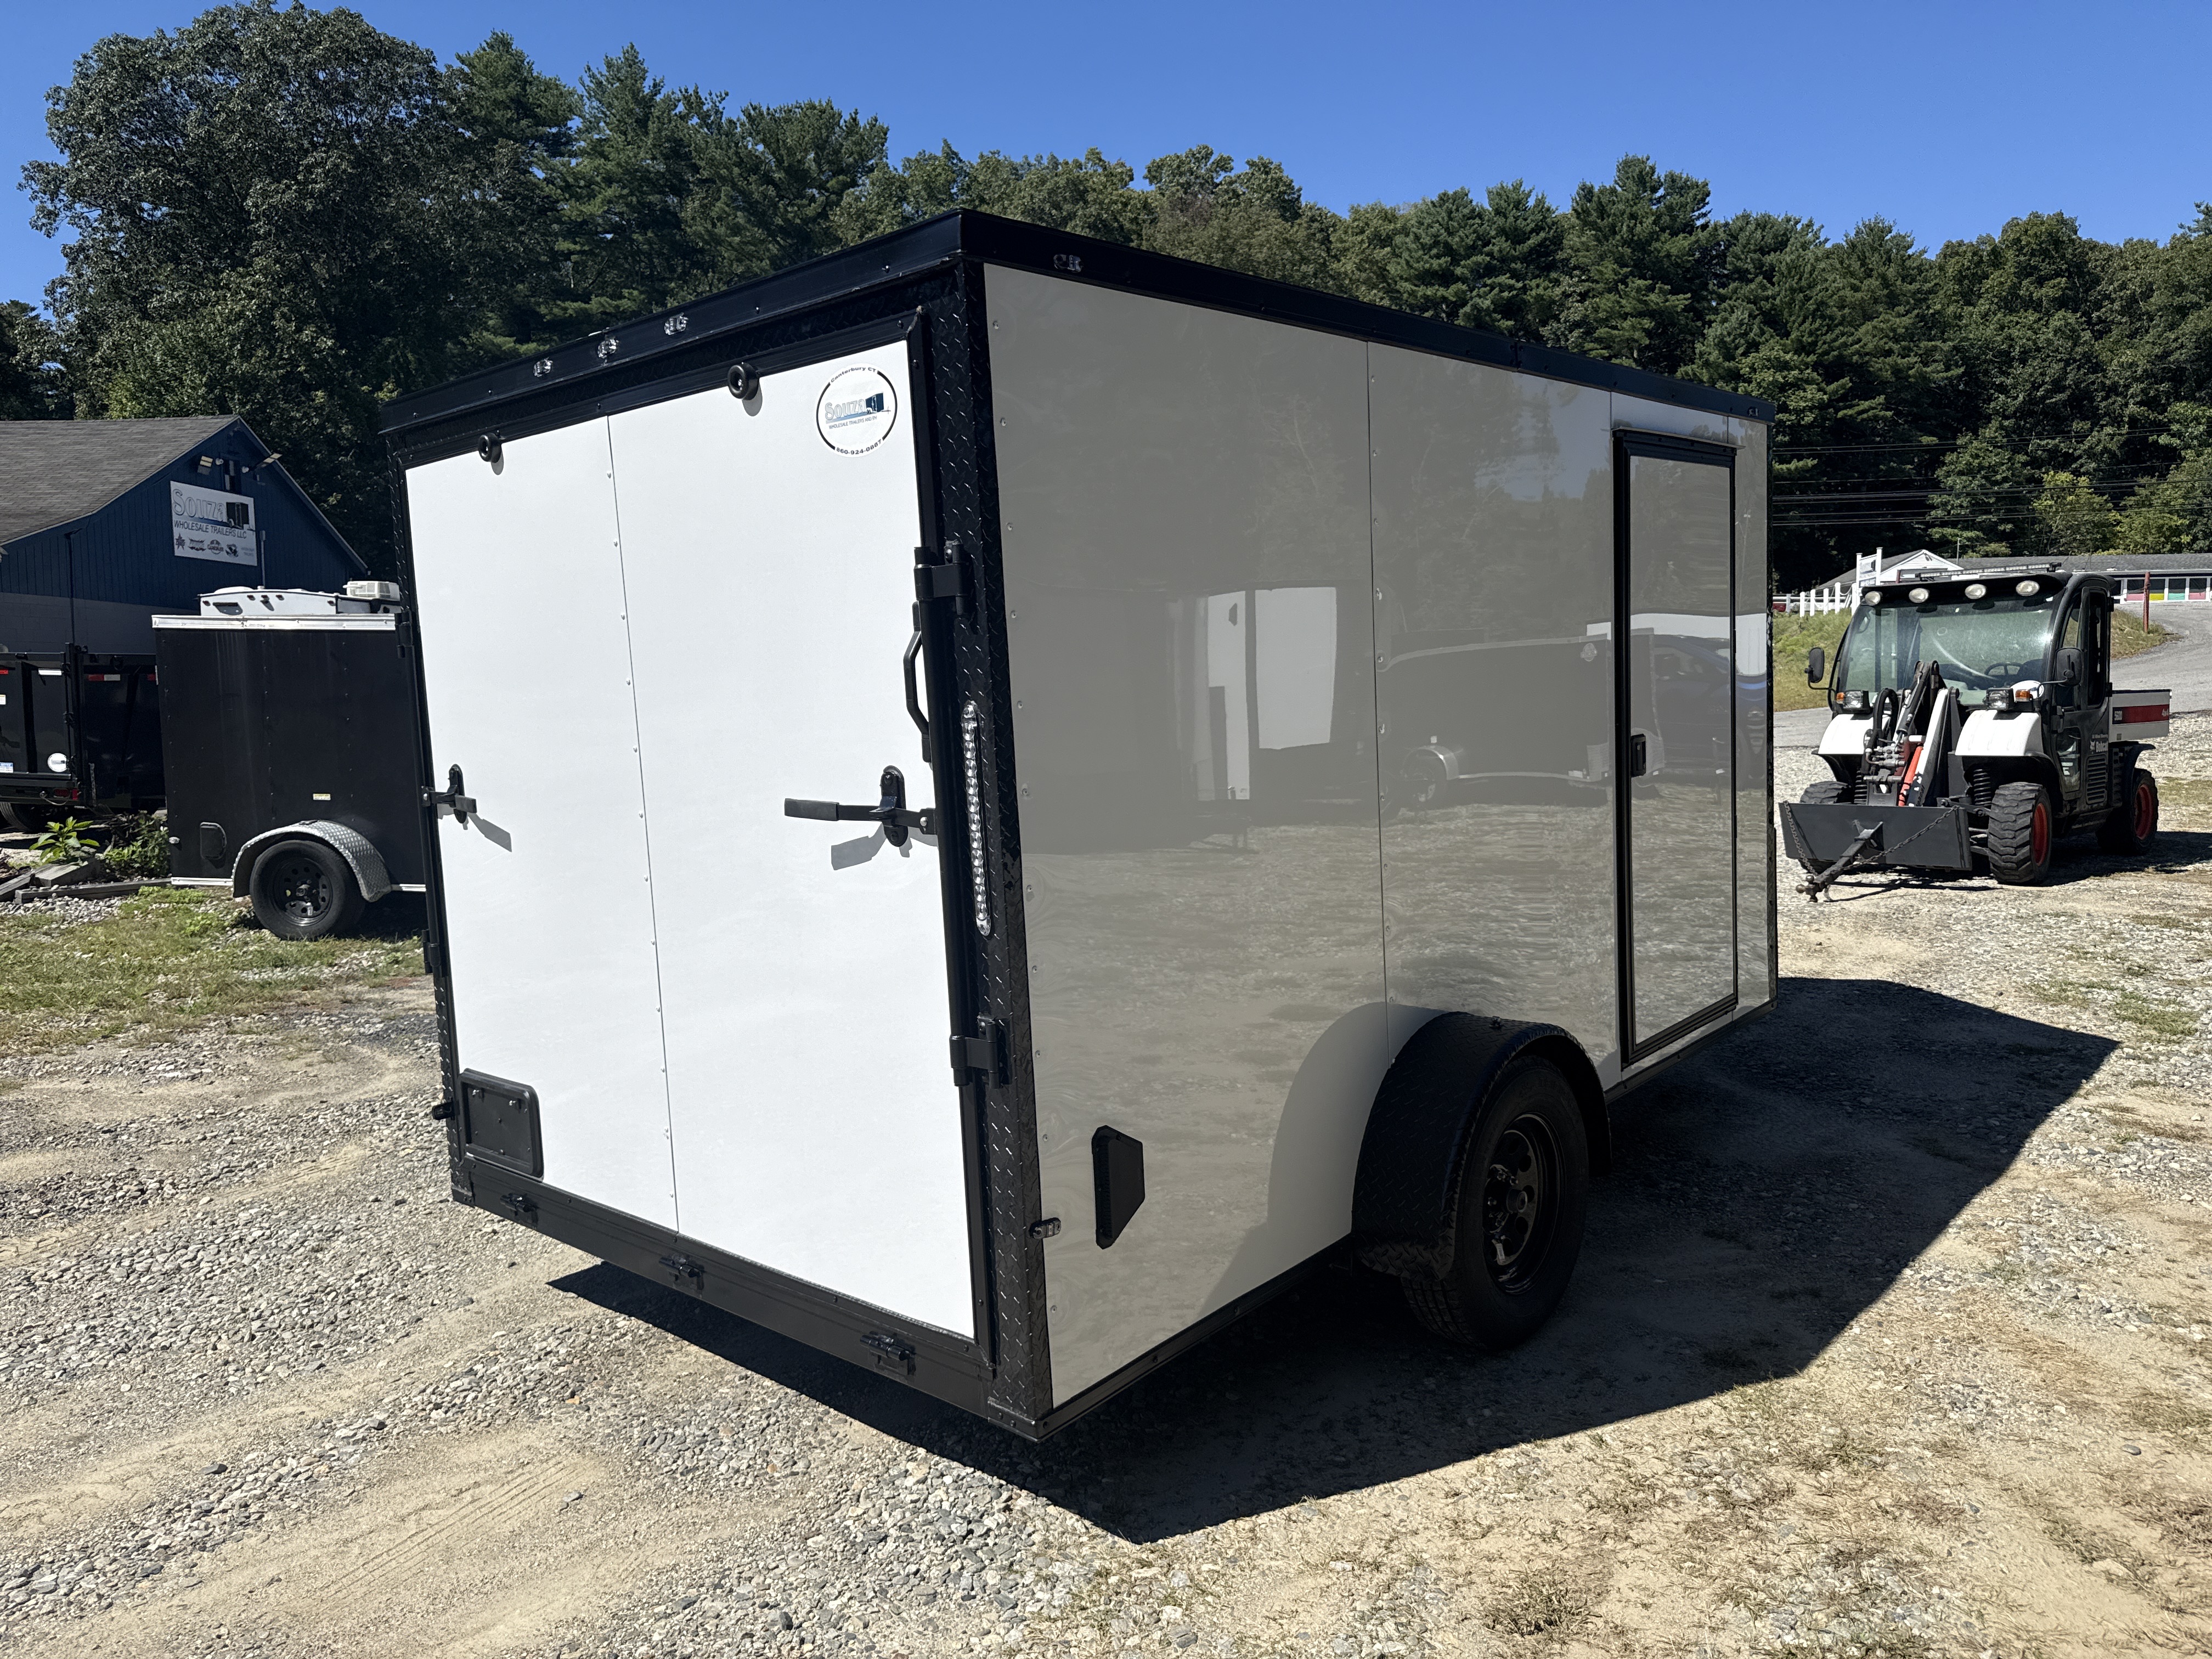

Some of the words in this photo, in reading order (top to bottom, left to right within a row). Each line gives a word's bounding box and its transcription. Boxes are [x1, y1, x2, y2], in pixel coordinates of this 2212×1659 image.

[831, 366, 866, 383] Canterbury
[825, 399, 866, 420] Souza
[173, 489, 225, 522] Souza
[174, 520, 209, 533] WHOLESALE
[211, 526, 236, 538] TRAILERS
